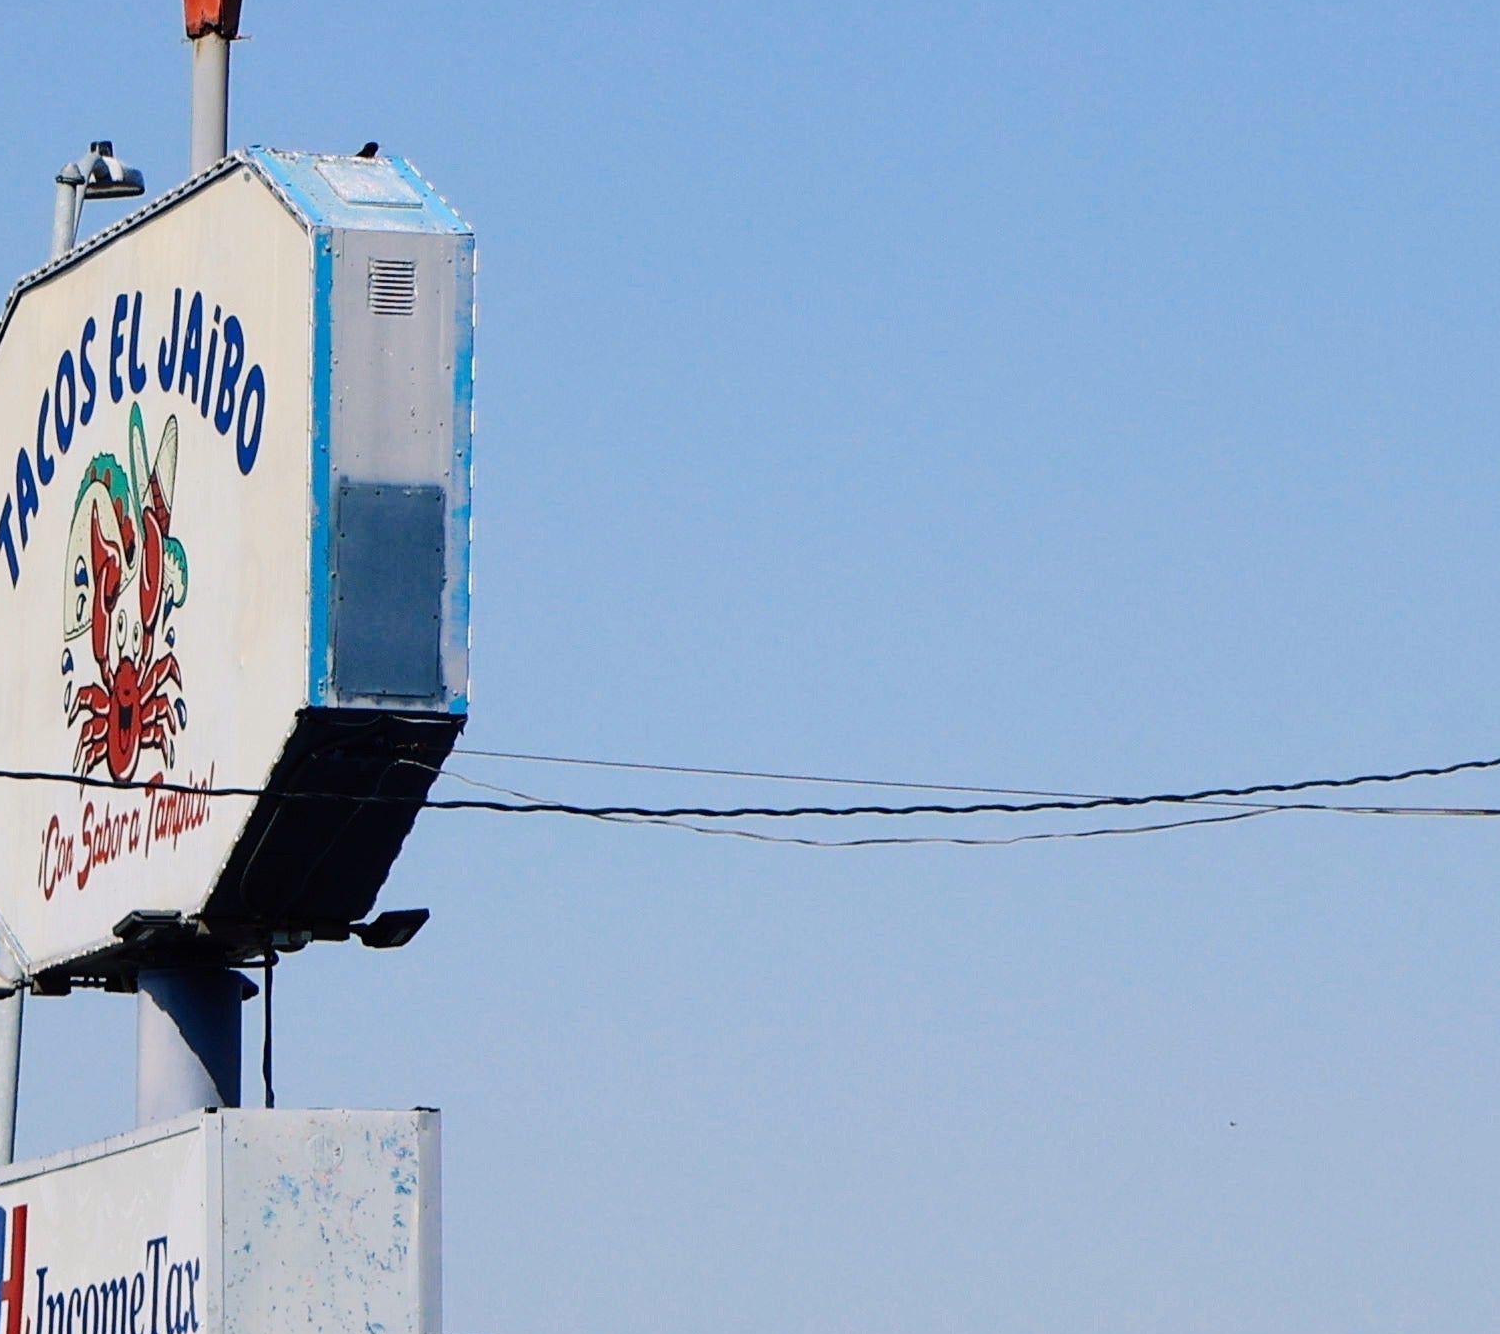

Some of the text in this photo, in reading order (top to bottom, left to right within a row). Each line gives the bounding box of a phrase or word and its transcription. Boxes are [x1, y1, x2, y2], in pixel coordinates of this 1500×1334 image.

[109, 290, 147, 404] EL
[77, 801, 129, 891] Sabor
[129, 808, 141, 854] a
[144, 760, 215, 859] Tampico!
